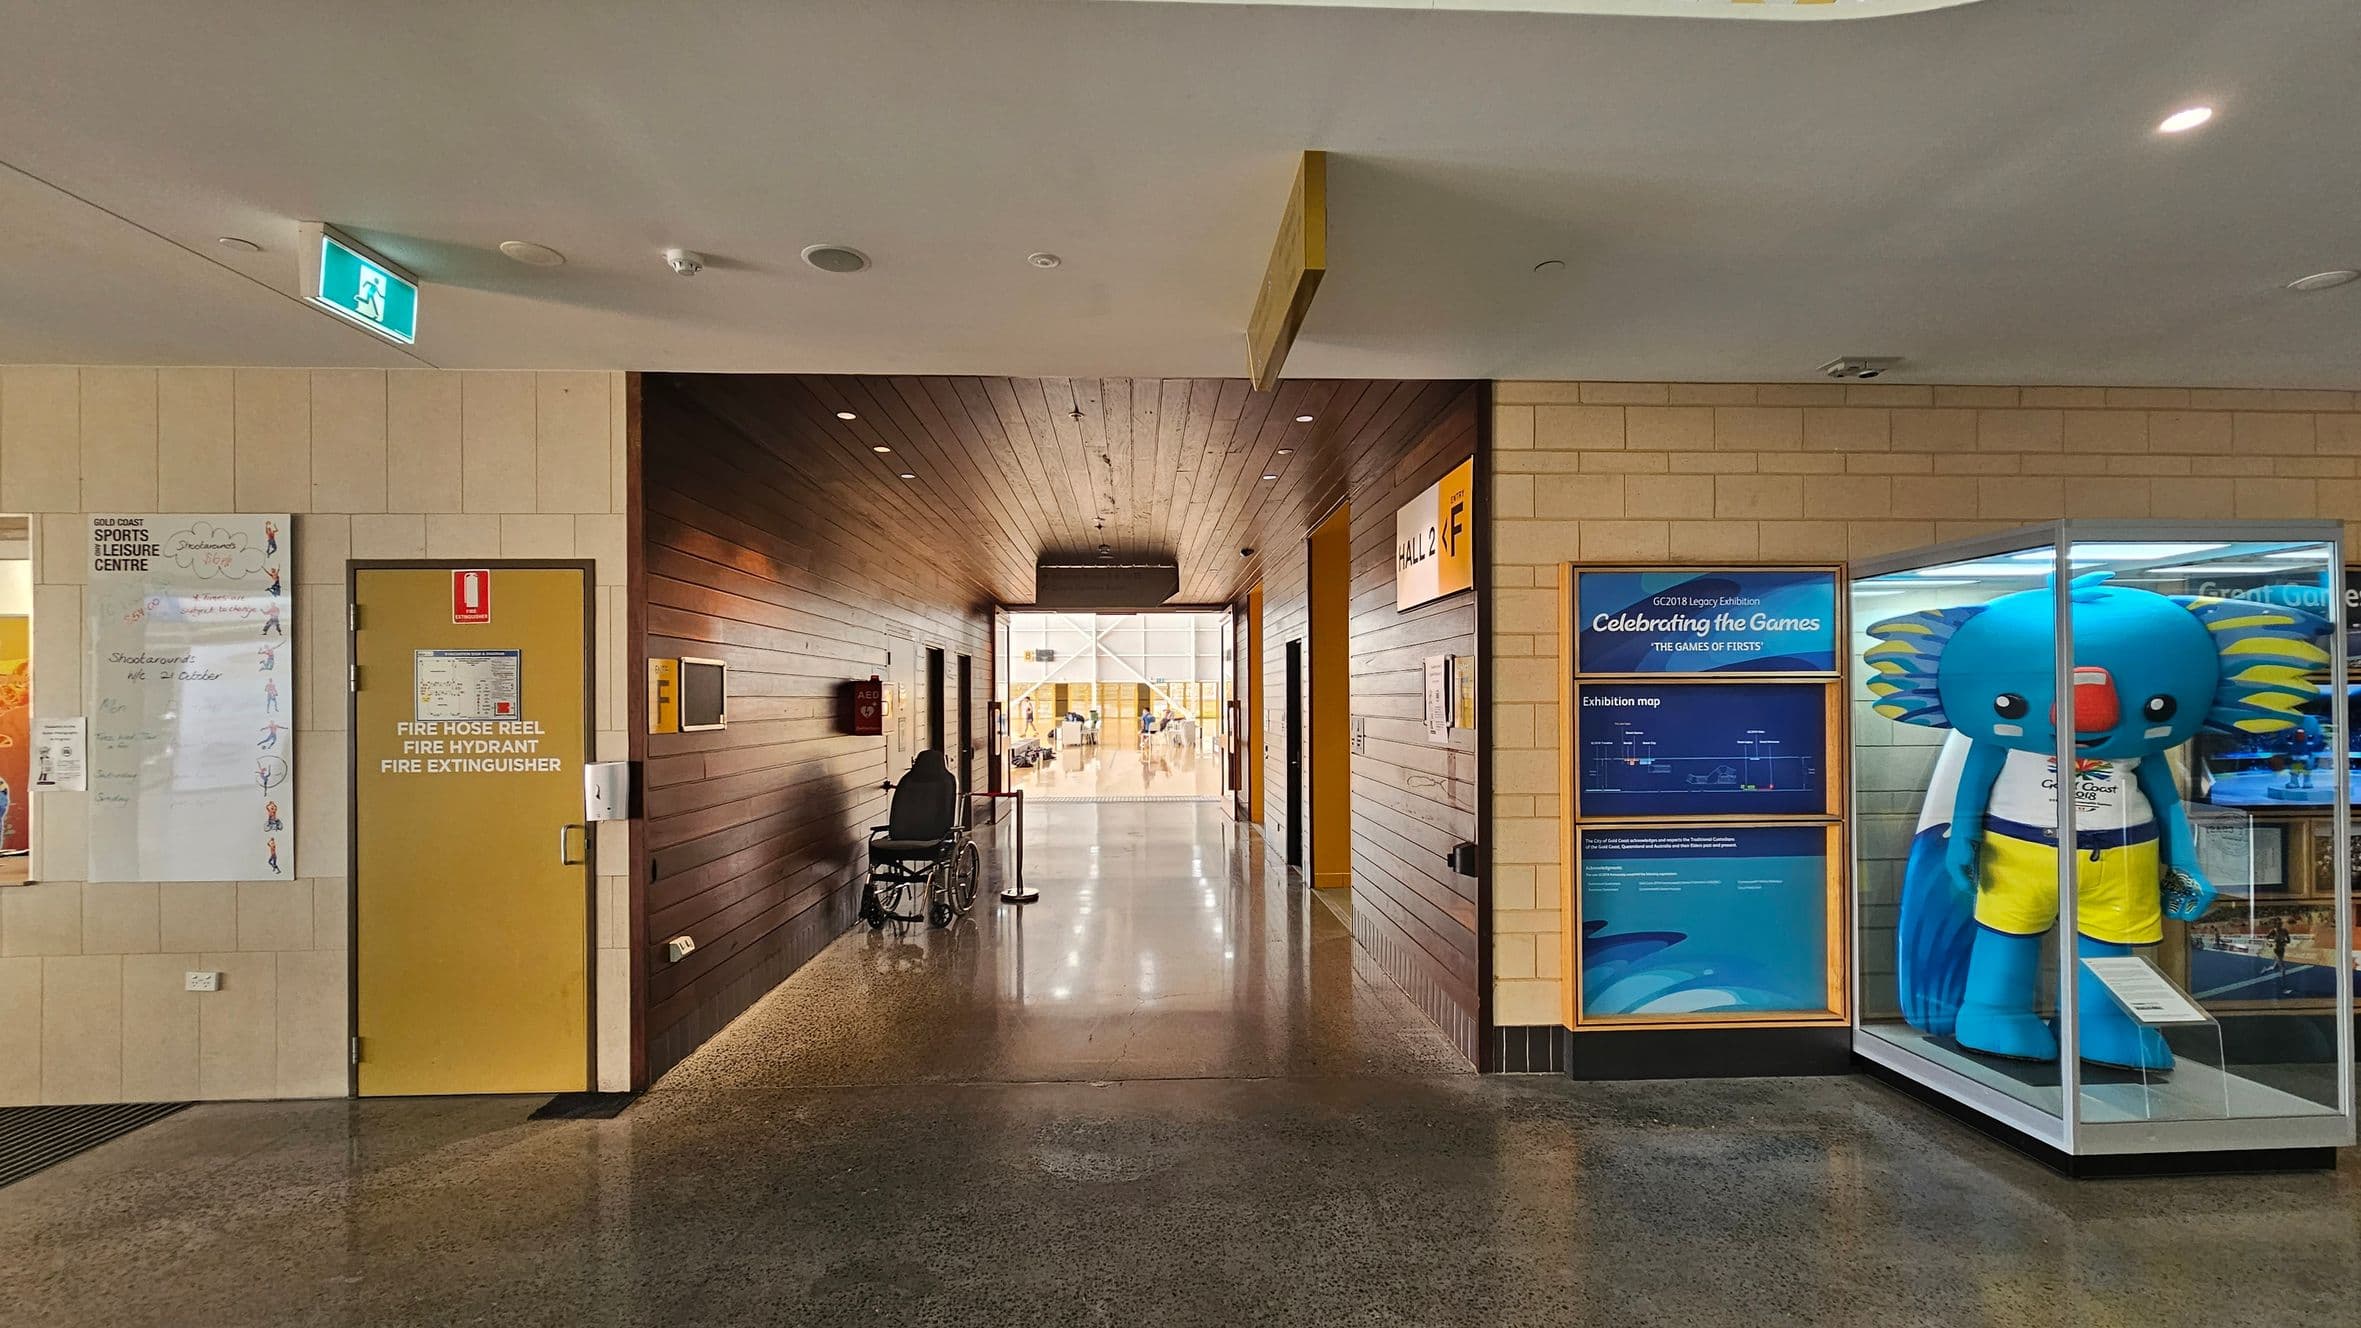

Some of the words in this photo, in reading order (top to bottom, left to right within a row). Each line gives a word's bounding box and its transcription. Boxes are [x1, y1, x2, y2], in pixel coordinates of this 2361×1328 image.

[94, 518, 116, 527] GOLD
[117, 518, 144, 527] COAST
[1451, 501, 1464, 557] F
[94, 529, 149, 542] SPORTS
[103, 544, 160, 556] LEISURE
[1398, 533, 1426, 572] HALL
[1428, 526, 1436, 557] 2
[94, 559, 149, 571] CENTRE
[1653, 596, 1687, 606] GC2018
[1689, 597, 1717, 608] Legacy
[1719, 596, 1760, 606] Exhibition
[1592, 613, 1711, 637] Celebrating
[1714, 613, 1746, 632] the
[1749, 612, 1820, 632] Games
[1675, 642, 1710, 652] GAMES
[1712, 642, 1725, 651] OF
[857, 691, 880, 699] AED
[656, 680, 670, 724] F
[1583, 697, 1635, 707] Exhibition
[1637, 698, 1661, 709] map
[397, 722, 438, 736] FIRE
[443, 721, 493, 735] HOSE
[499, 721, 545, 735] REEL
[404, 740, 444, 754] FIRE
[450, 739, 539, 753] HYDRANT
[381, 759, 422, 773] FIRE
[427, 758, 561, 773] EXTINGUISHER
[2082, 782, 2118, 793] Coast
